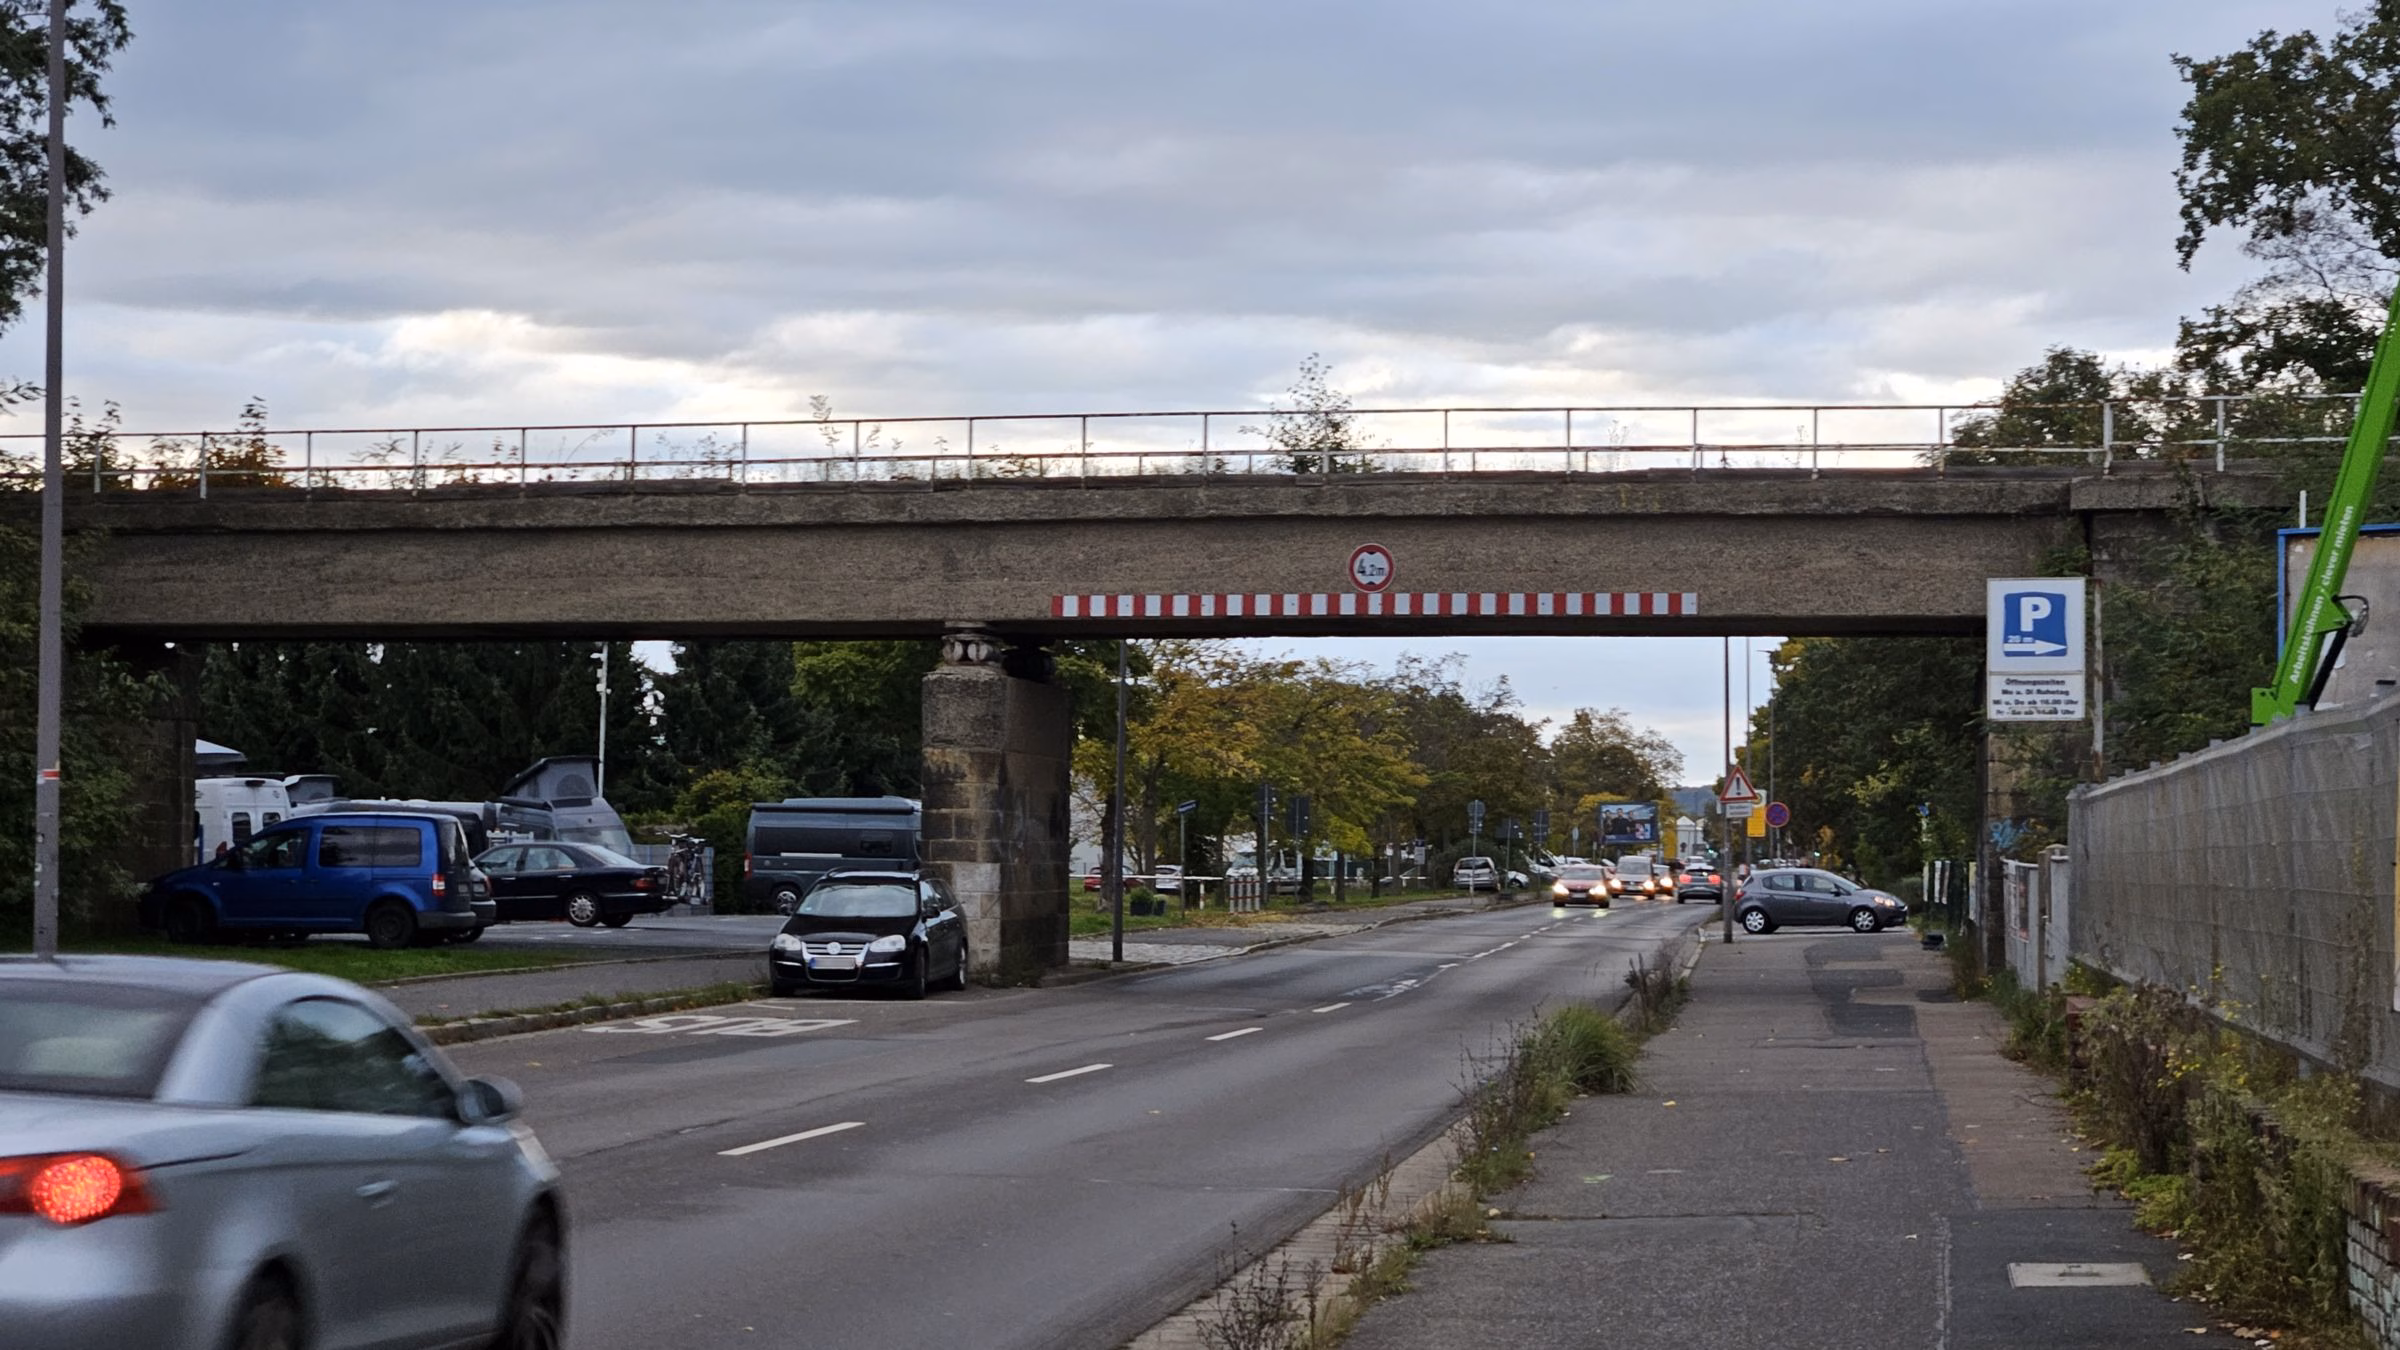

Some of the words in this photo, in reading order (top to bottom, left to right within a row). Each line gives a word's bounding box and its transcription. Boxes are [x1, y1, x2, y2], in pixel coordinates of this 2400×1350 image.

[2321, 551, 2339, 586] clever
[2334, 505, 2354, 549] mieten
[2020, 596, 2052, 632] P
[2004, 678, 2066, 686] Öffnungszeiten
